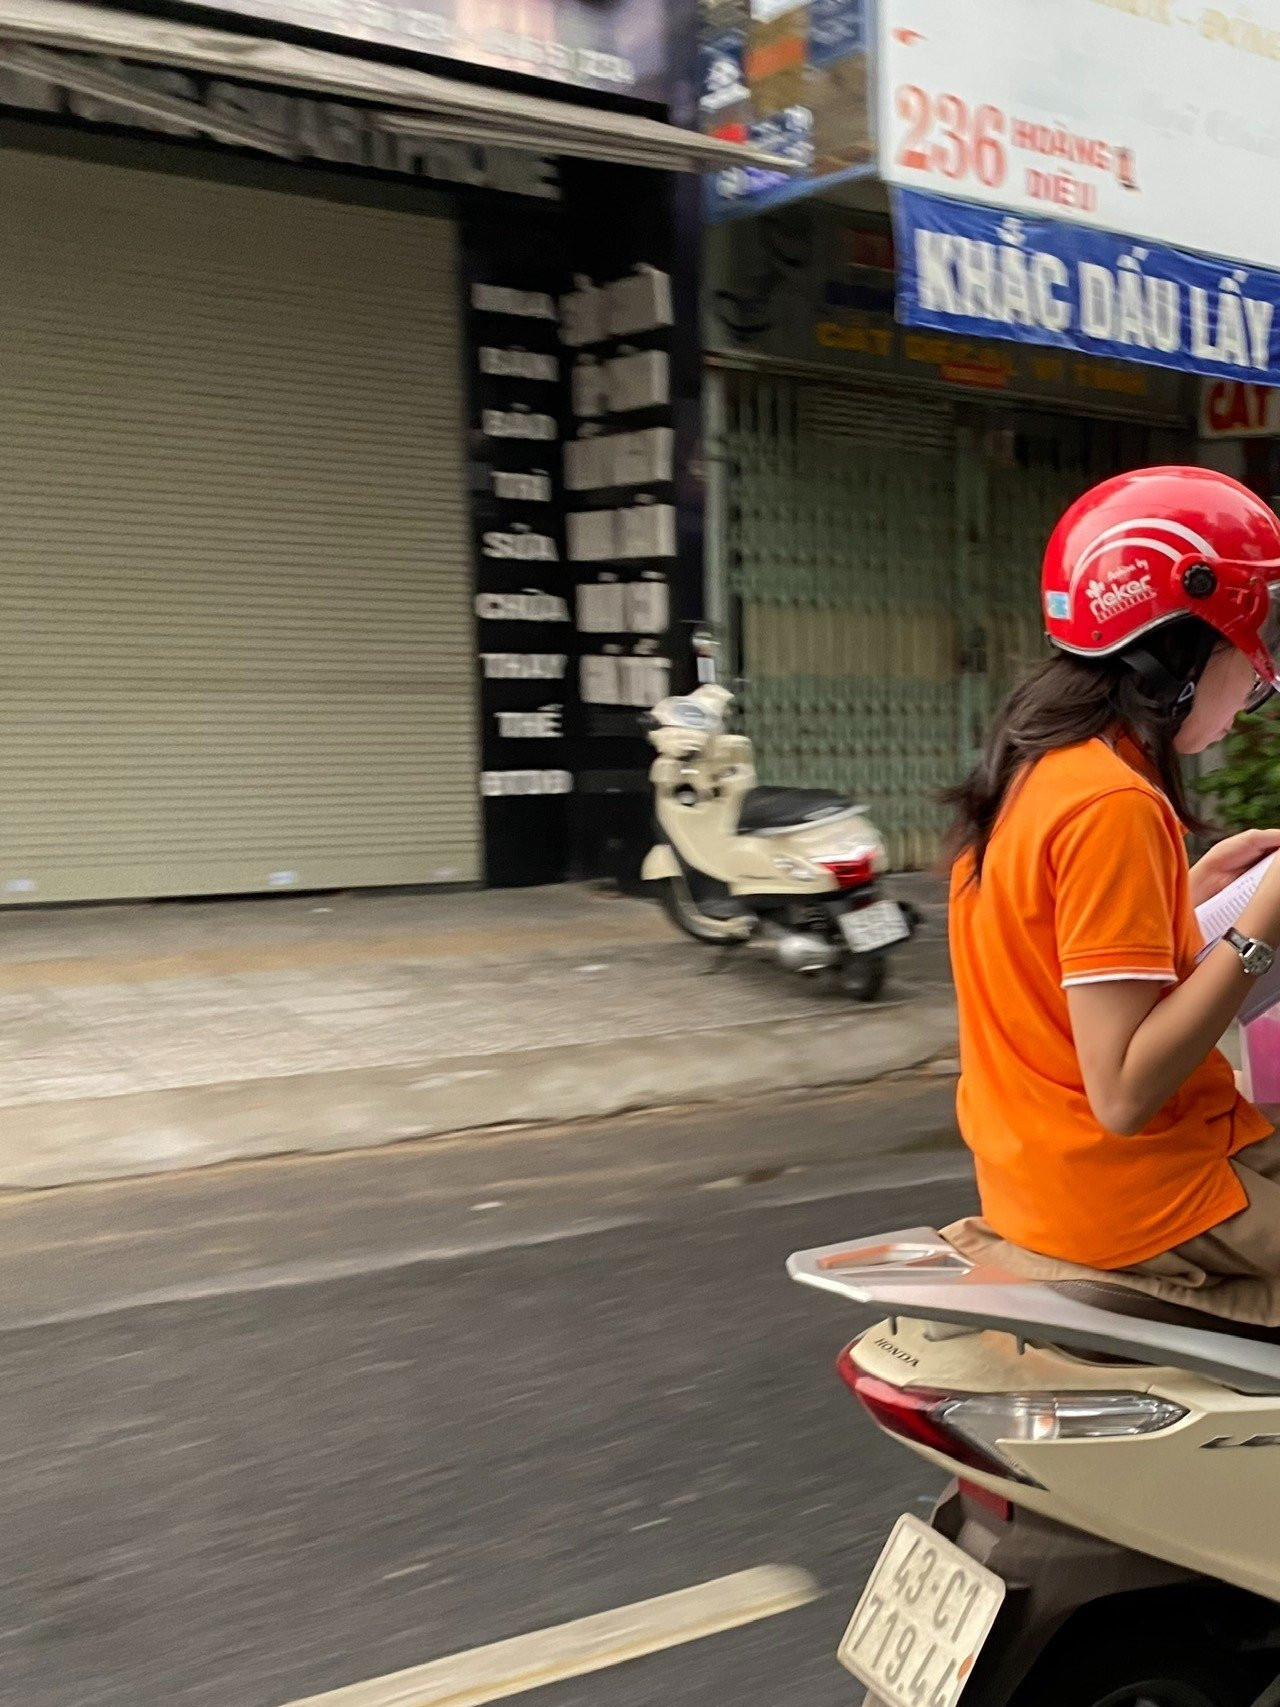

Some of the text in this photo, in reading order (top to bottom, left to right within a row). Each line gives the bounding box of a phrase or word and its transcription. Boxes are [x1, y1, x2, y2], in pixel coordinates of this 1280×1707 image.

[895, 83, 1009, 189] 236
[1077, 246, 1181, 354] DẤU
[1188, 268, 1275, 372] LẤY
[874, 1337, 920, 1367] HONDA
